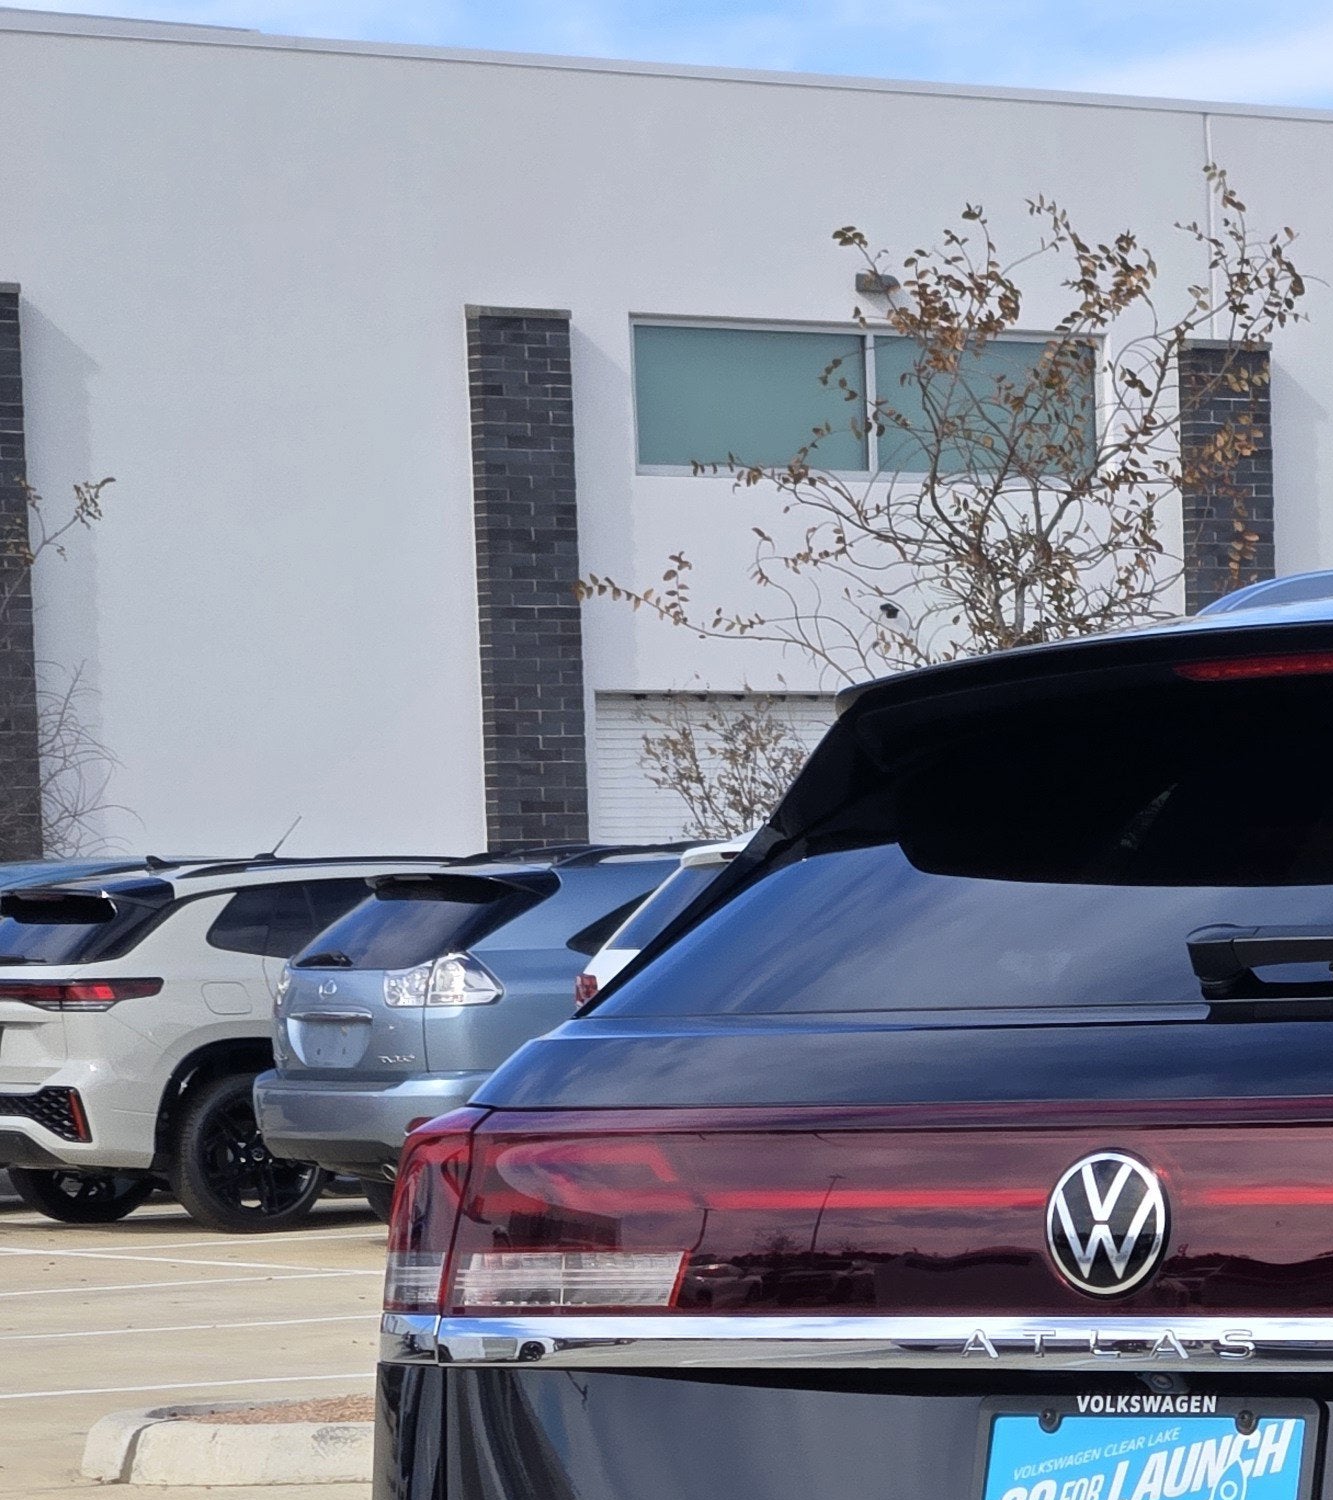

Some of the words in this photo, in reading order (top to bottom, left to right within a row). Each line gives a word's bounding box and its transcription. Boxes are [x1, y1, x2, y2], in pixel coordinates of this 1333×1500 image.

[961, 1328, 1257, 1360] ATLAS
[1076, 1394, 1217, 1413] VOLKSWAGEN
[1013, 1447, 1102, 1481] VOLKSWAGEN
[1103, 1435, 1146, 1458] CLEAR
[1147, 1426, 1182, 1446] LAKE
